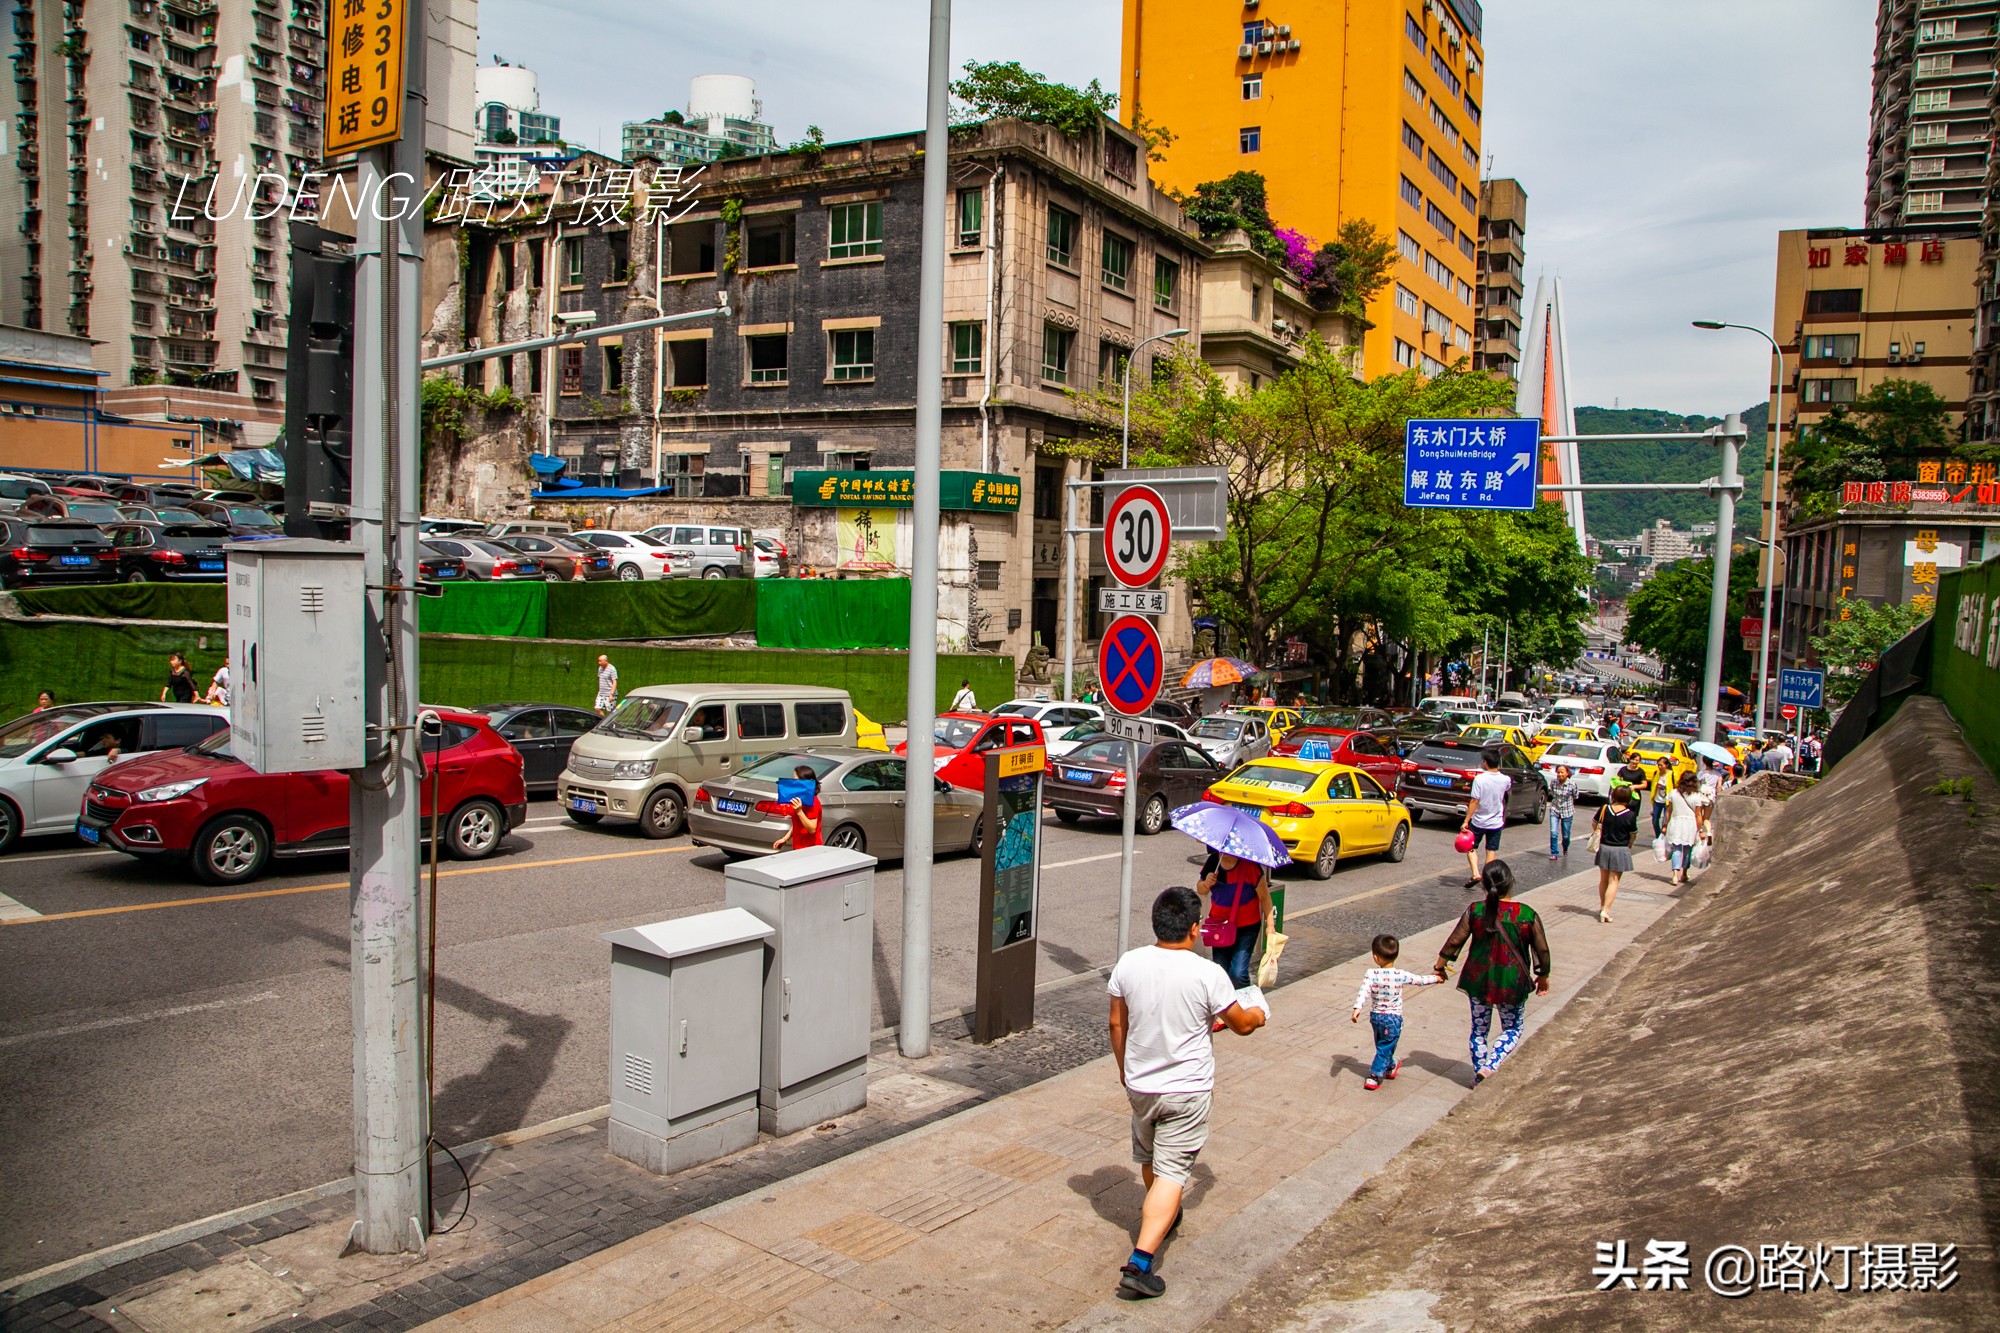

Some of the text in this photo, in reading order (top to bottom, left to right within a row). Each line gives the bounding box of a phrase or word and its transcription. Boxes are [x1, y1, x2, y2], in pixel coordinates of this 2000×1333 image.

[1807, 240, 1945, 268] 如家酒店
[1412, 426, 1507, 447] 东水门大桥
[840, 478, 915, 493] 中国邮政储蓄
[988, 482, 1018, 496] 中国邮政
[1410, 469, 1504, 491] 解放东路
[1419, 492, 1450, 502] JieFang
[1480, 493, 1494, 501] Rd.
[1118, 509, 1154, 563] 30
[1104, 592, 1163, 611] 施工区域
[1111, 718, 1133, 737] 90 m
